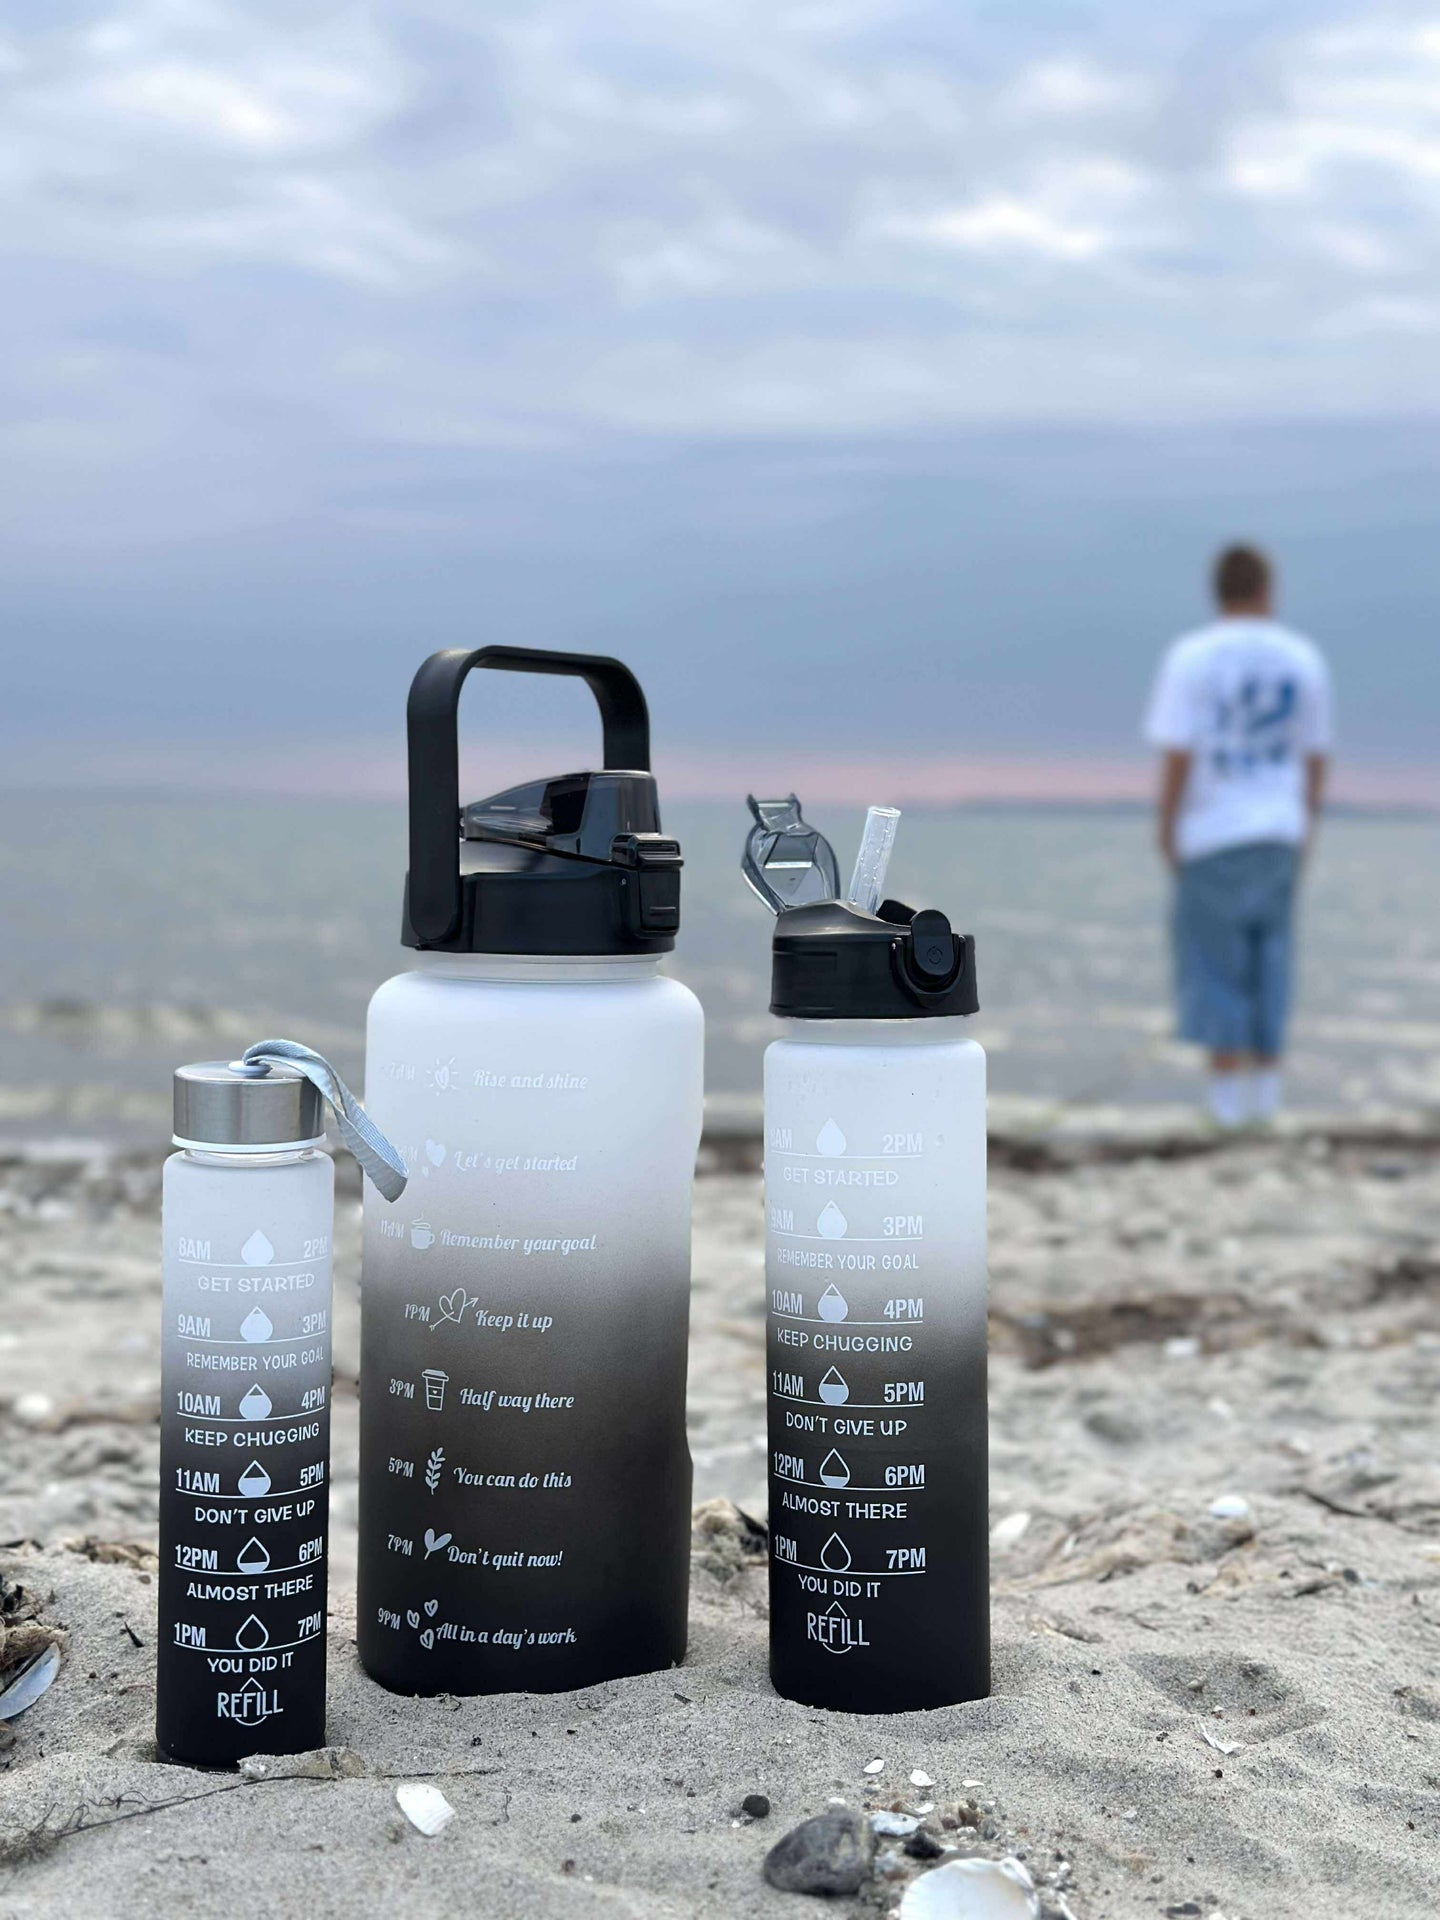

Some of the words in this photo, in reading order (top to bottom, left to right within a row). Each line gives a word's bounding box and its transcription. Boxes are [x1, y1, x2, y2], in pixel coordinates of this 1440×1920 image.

[473, 1068, 506, 1088] Rise
[511, 1073, 543, 1088] and
[547, 1073, 588, 1090] shine
[883, 1133, 923, 1153] 2PM
[454, 1151, 491, 1172] Let's
[495, 1155, 519, 1174] get
[523, 1155, 578, 1171] started
[784, 1167, 809, 1183] GET
[814, 1170, 899, 1186] STARTED
[771, 1208, 793, 1231] 9AM
[883, 1216, 923, 1235] 3PM
[179, 1237, 210, 1260] 8AM
[304, 1237, 327, 1258] 2PM
[440, 1229, 519, 1250] Remember
[778, 1248, 833, 1269] REMEMBER
[838, 1254, 875, 1270] YOUR
[882, 1255, 919, 1269] GOAL
[198, 1275, 231, 1292] GET
[238, 1274, 314, 1292] STARTED
[773, 1290, 803, 1314] 10AM
[883, 1299, 923, 1318] 4PM
[178, 1314, 210, 1337] 9AM
[303, 1310, 326, 1333] 3PM
[404, 1303, 430, 1321] 1PM
[475, 1310, 513, 1331] Keep
[517, 1313, 530, 1328] it
[533, 1316, 553, 1332] up
[777, 1328, 809, 1347] KEEP
[813, 1335, 913, 1352] CHUGGING
[187, 1352, 258, 1371] REMEMBER
[263, 1352, 297, 1370] YOUR
[301, 1349, 324, 1366] GOAL
[389, 1379, 414, 1399] 3PM
[460, 1388, 497, 1411] Half
[499, 1395, 532, 1412] way
[535, 1393, 574, 1409] there
[773, 1370, 803, 1397] 11AM
[884, 1382, 924, 1403] 5PM
[177, 1391, 220, 1415] 10AM
[301, 1386, 325, 1409] 4PM
[185, 1428, 228, 1446] KEEP
[233, 1423, 319, 1447] CHUGGING
[786, 1411, 828, 1433] DON'T
[834, 1419, 874, 1436] GIVE
[880, 1420, 907, 1436] UP
[300, 1460, 324, 1486] 5PM
[389, 1457, 413, 1478] 5PM
[453, 1467, 483, 1486] You
[486, 1472, 515, 1487] can
[519, 1471, 538, 1488] do
[543, 1472, 572, 1488] this
[774, 1451, 804, 1480] 12PM
[885, 1464, 925, 1486] 6PM
[176, 1468, 220, 1494] 11AM
[195, 1507, 248, 1525] DON'T
[254, 1506, 292, 1523] GIVE
[296, 1500, 315, 1517] UP
[782, 1492, 840, 1517] ALMOST
[846, 1502, 907, 1519] THERE
[176, 1544, 218, 1570] 12PM
[299, 1536, 322, 1562] 6PM
[388, 1534, 413, 1556] 7PM
[448, 1546, 489, 1565] Don't
[493, 1550, 524, 1571] quit
[527, 1551, 563, 1567] now!
[775, 1534, 797, 1562] 1PM
[886, 1548, 926, 1569] 7PM
[187, 1582, 259, 1601] ALMOST
[265, 1574, 313, 1599] THERE
[798, 1574, 828, 1594] YOU
[833, 1580, 861, 1597] DID
[867, 1582, 881, 1598] IT
[174, 1622, 206, 1647] 1PM
[298, 1611, 321, 1638] 7PM
[378, 1607, 400, 1630] 9PM
[436, 1623, 457, 1640] All
[461, 1629, 476, 1642] in
[477, 1631, 488, 1643] a
[493, 1628, 535, 1650] day's
[538, 1627, 577, 1644] work
[807, 1612, 870, 1646] REFILL
[208, 1658, 242, 1673] YOU
[249, 1656, 277, 1673] DID
[282, 1652, 294, 1668] IT
[217, 1690, 283, 1718] REFILL
